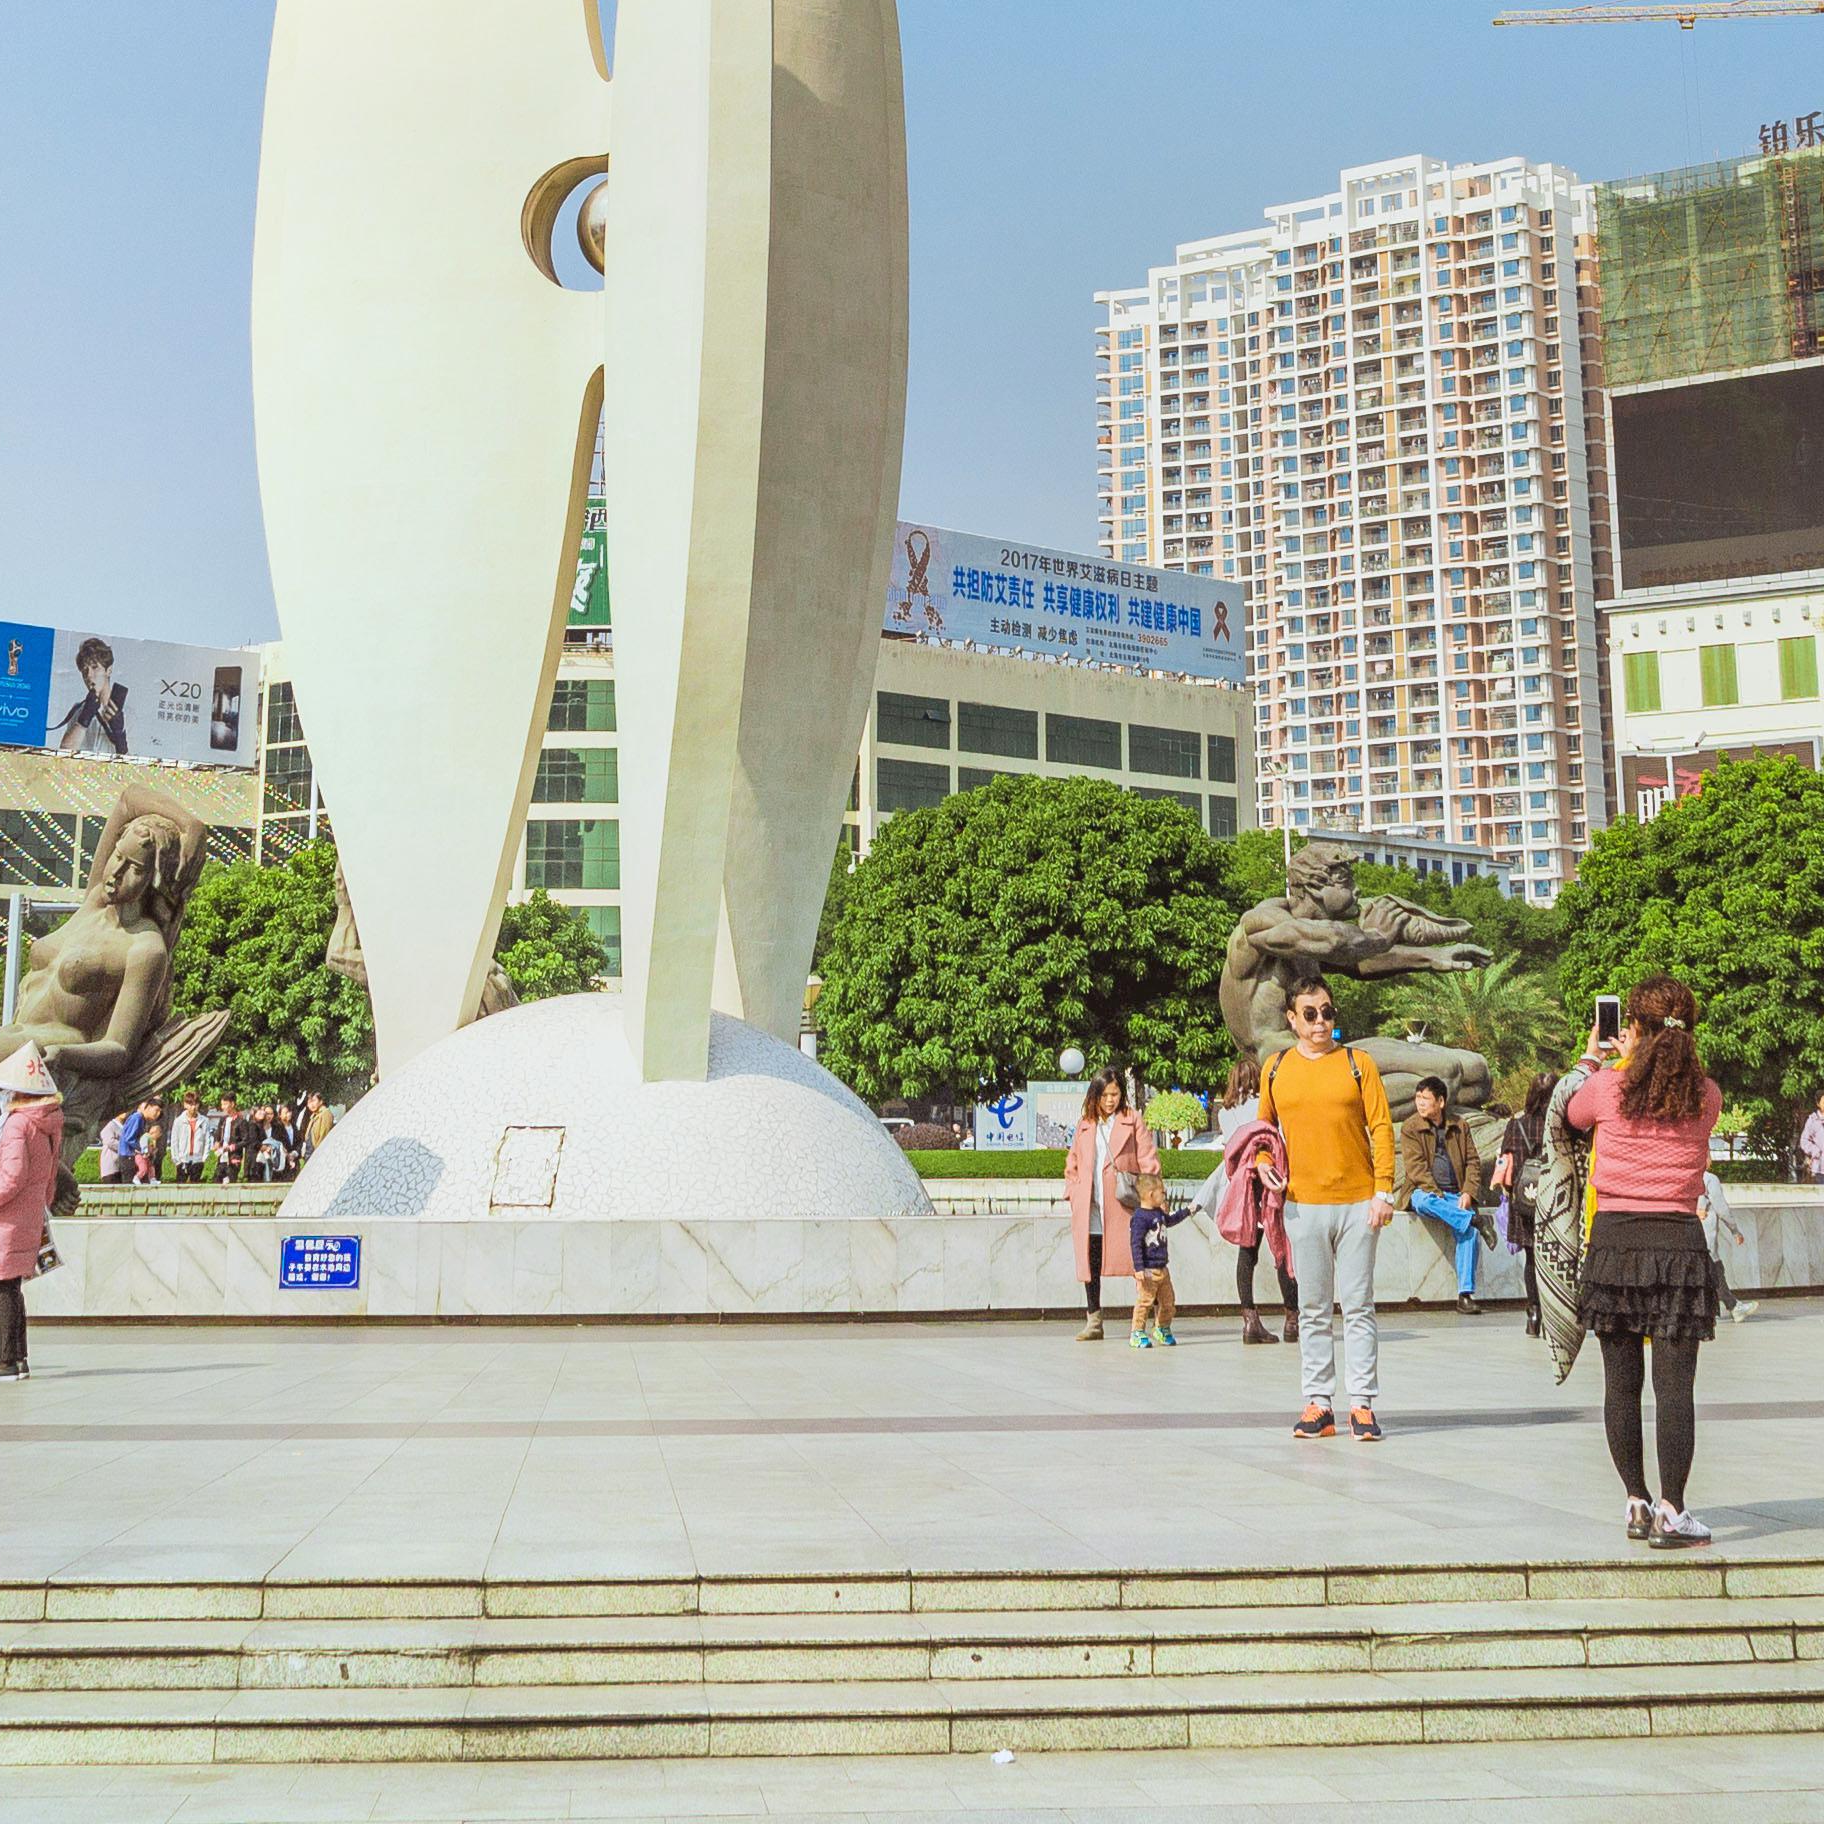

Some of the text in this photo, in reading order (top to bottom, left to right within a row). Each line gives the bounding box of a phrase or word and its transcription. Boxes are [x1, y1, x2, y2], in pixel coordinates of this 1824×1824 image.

[1000, 547, 1160, 593] 2017年世界艾滋病日主题
[952, 565, 1036, 610] 共担防艾责任
[1042, 581, 1121, 625] 共享健康权利
[1127, 595, 1202, 639] 共建健康中国
[989, 616, 1079, 647] 主动检测 减少焦虑
[160, 679, 202, 700] X20
